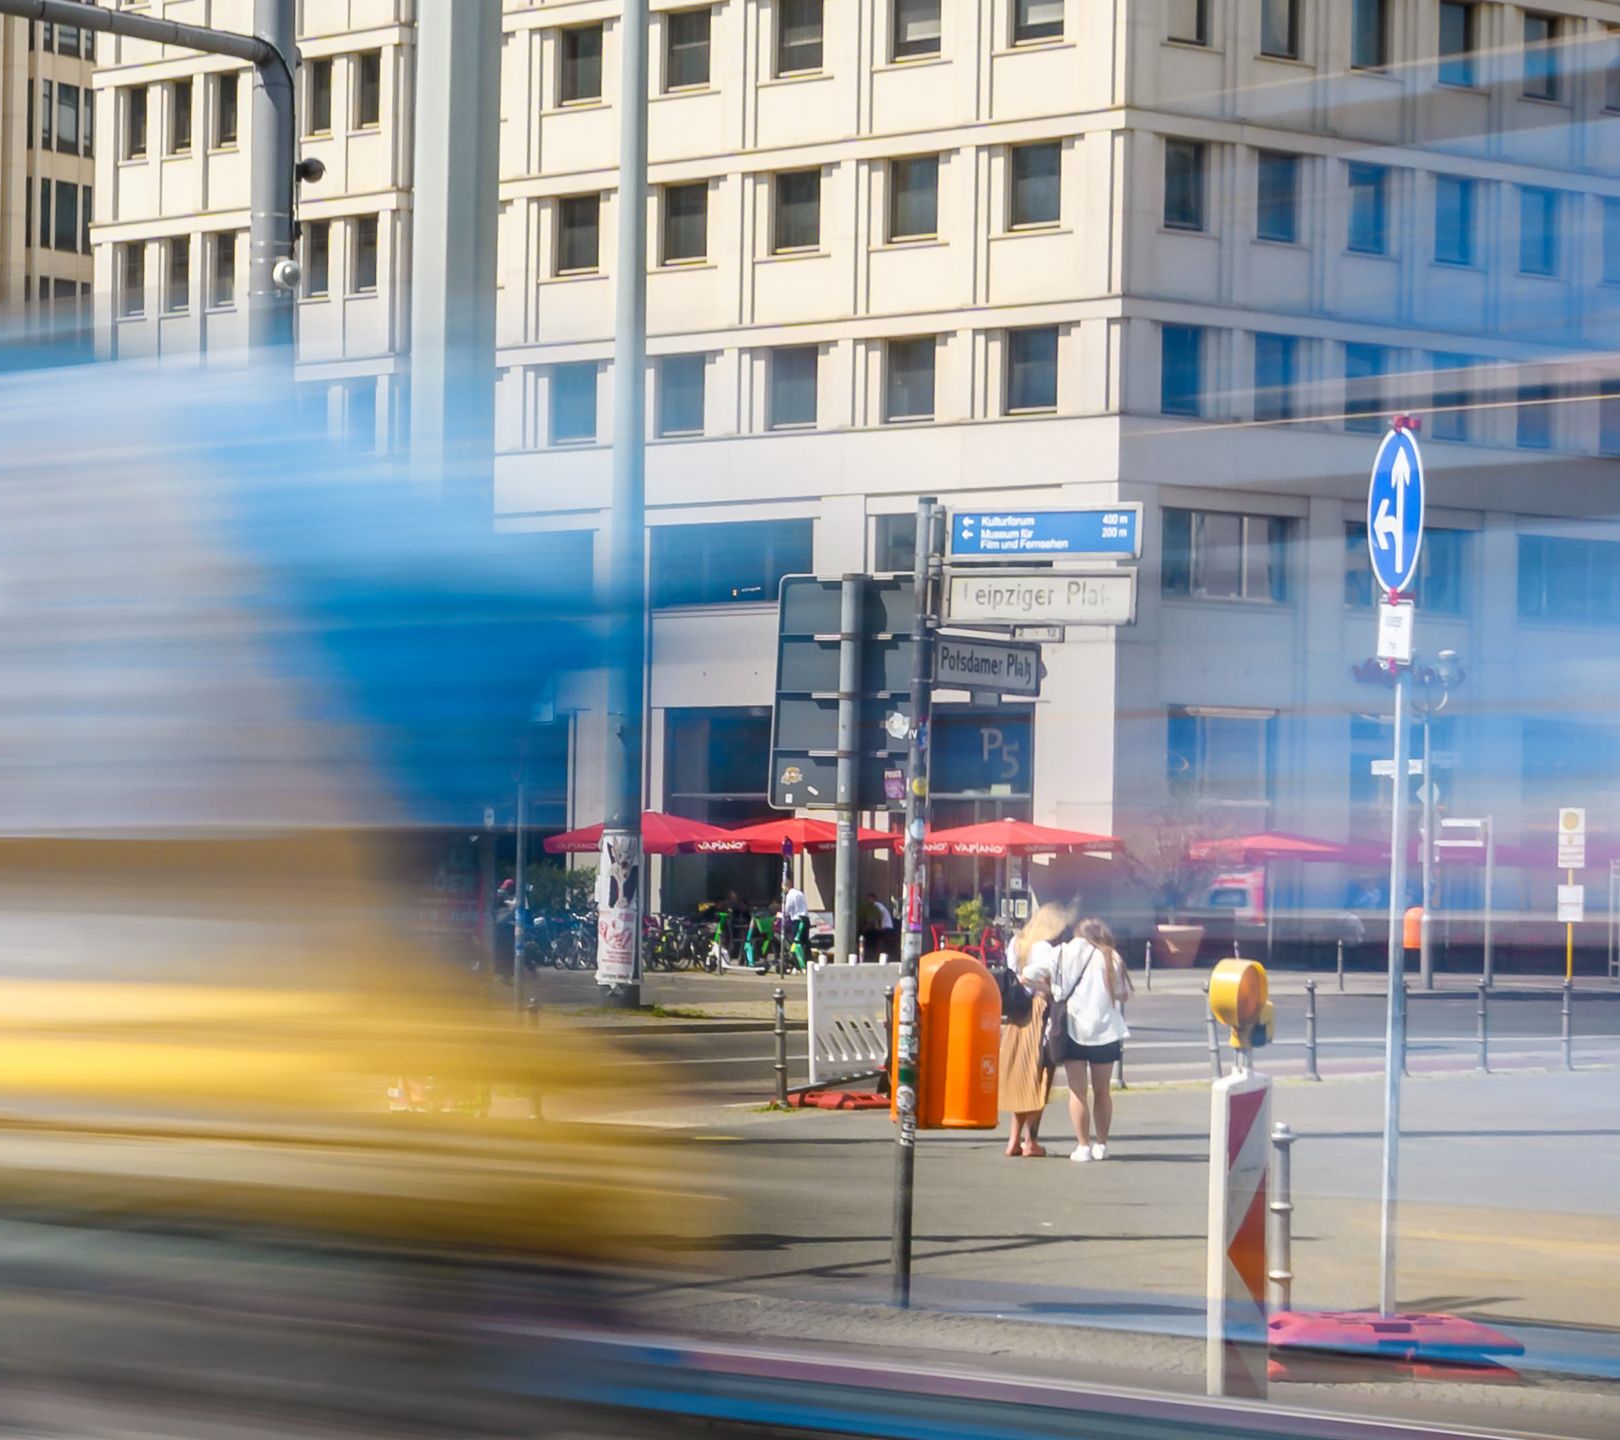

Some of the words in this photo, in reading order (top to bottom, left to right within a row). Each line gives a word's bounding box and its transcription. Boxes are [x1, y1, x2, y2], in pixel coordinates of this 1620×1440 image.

[981, 516, 1035, 526] Kulturforum
[1102, 514, 1118, 524] 400
[1120, 516, 1128, 524] m
[981, 529, 1019, 538] Museum
[1020, 528, 1033, 538] für
[1102, 528, 1118, 538] 200
[1119, 529, 1127, 537] m
[980, 539, 999, 549] Film
[1001, 540, 1018, 549] und
[1019, 539, 1069, 549] Fernsehen
[941, 646, 1003, 676] Potsdamer
[1007, 653, 1032, 686] Platz
[697, 840, 745, 851] VAPIANO
[954, 842, 1004, 854] VAPIANO
